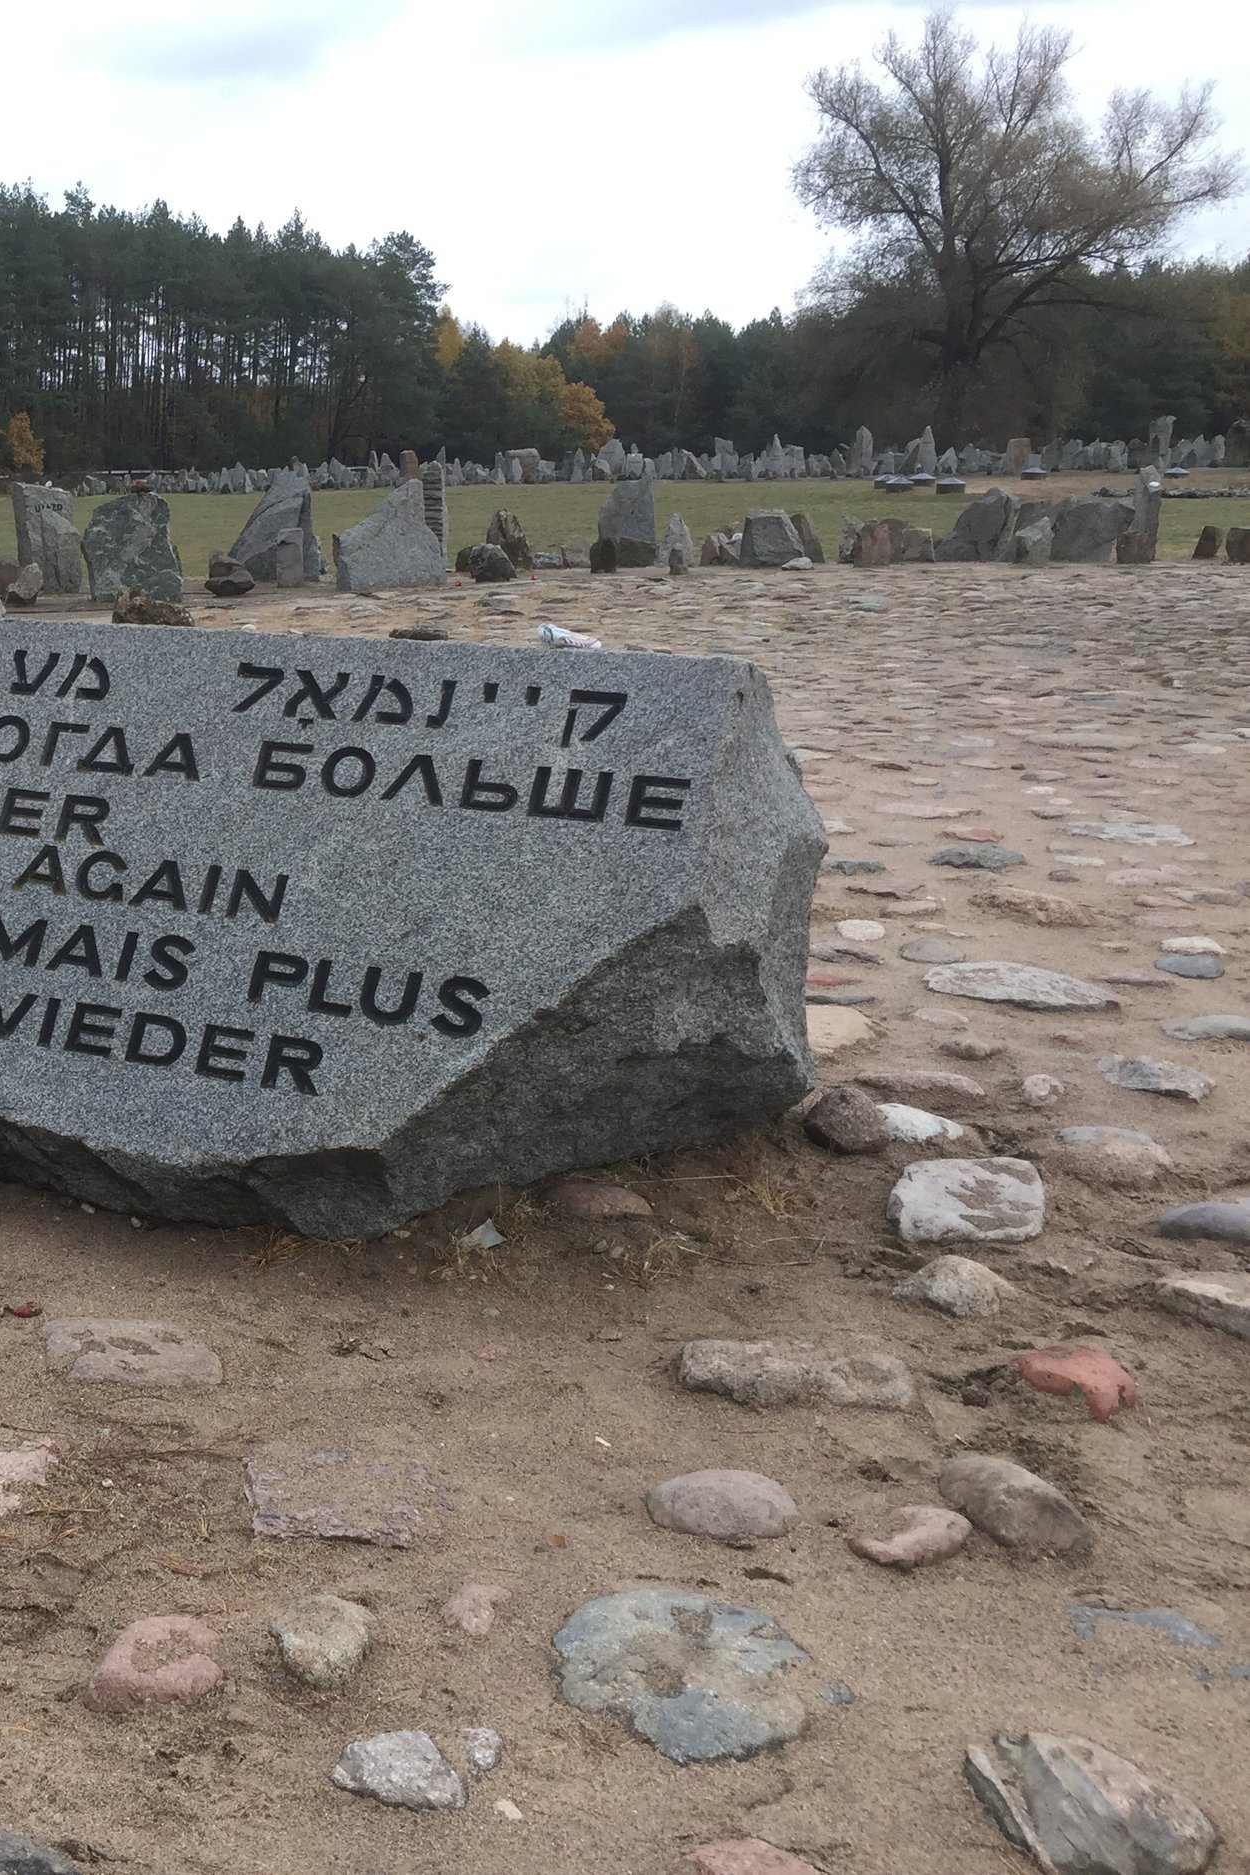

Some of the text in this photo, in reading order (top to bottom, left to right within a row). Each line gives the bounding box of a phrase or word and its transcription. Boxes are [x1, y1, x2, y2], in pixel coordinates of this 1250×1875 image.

[252, 740, 692, 832] БОЛЬШЕ
[11, 844, 290, 923] AGAIN
[246, 950, 491, 1040] PLUS
